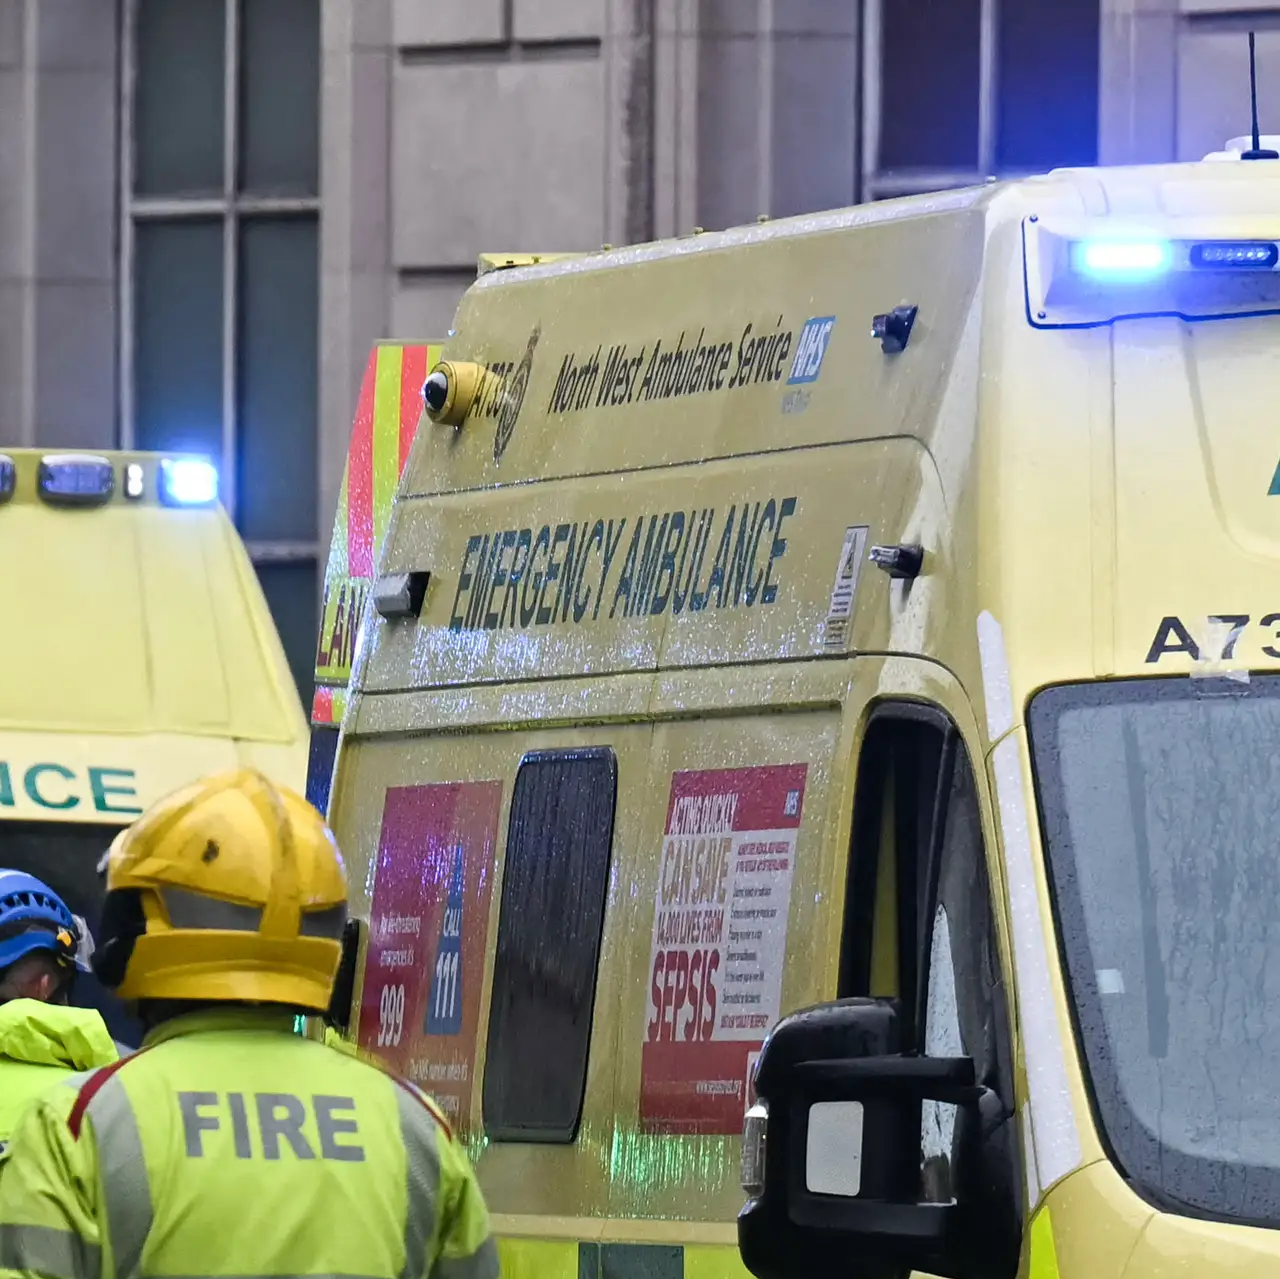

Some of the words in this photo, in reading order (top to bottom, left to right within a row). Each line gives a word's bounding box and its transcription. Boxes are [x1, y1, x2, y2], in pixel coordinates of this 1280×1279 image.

[547, 344, 602, 414] North
[595, 344, 646, 407] West
[637, 327, 733, 401] Ambulance
[728, 314, 792, 389] Service
[790, 320, 833, 380] NHS
[449, 518, 627, 633] EMERGENCY
[609, 496, 798, 618] AMBULANCE
[661, 839, 693, 906] CAN
[691, 837, 732, 905] SAVE
[443, 907, 460, 938] CALL
[377, 984, 406, 1048] 999
[435, 951, 459, 1019] 111
[647, 948, 720, 1042] SEPSIS
[177, 1091, 367, 1163] FIRE
